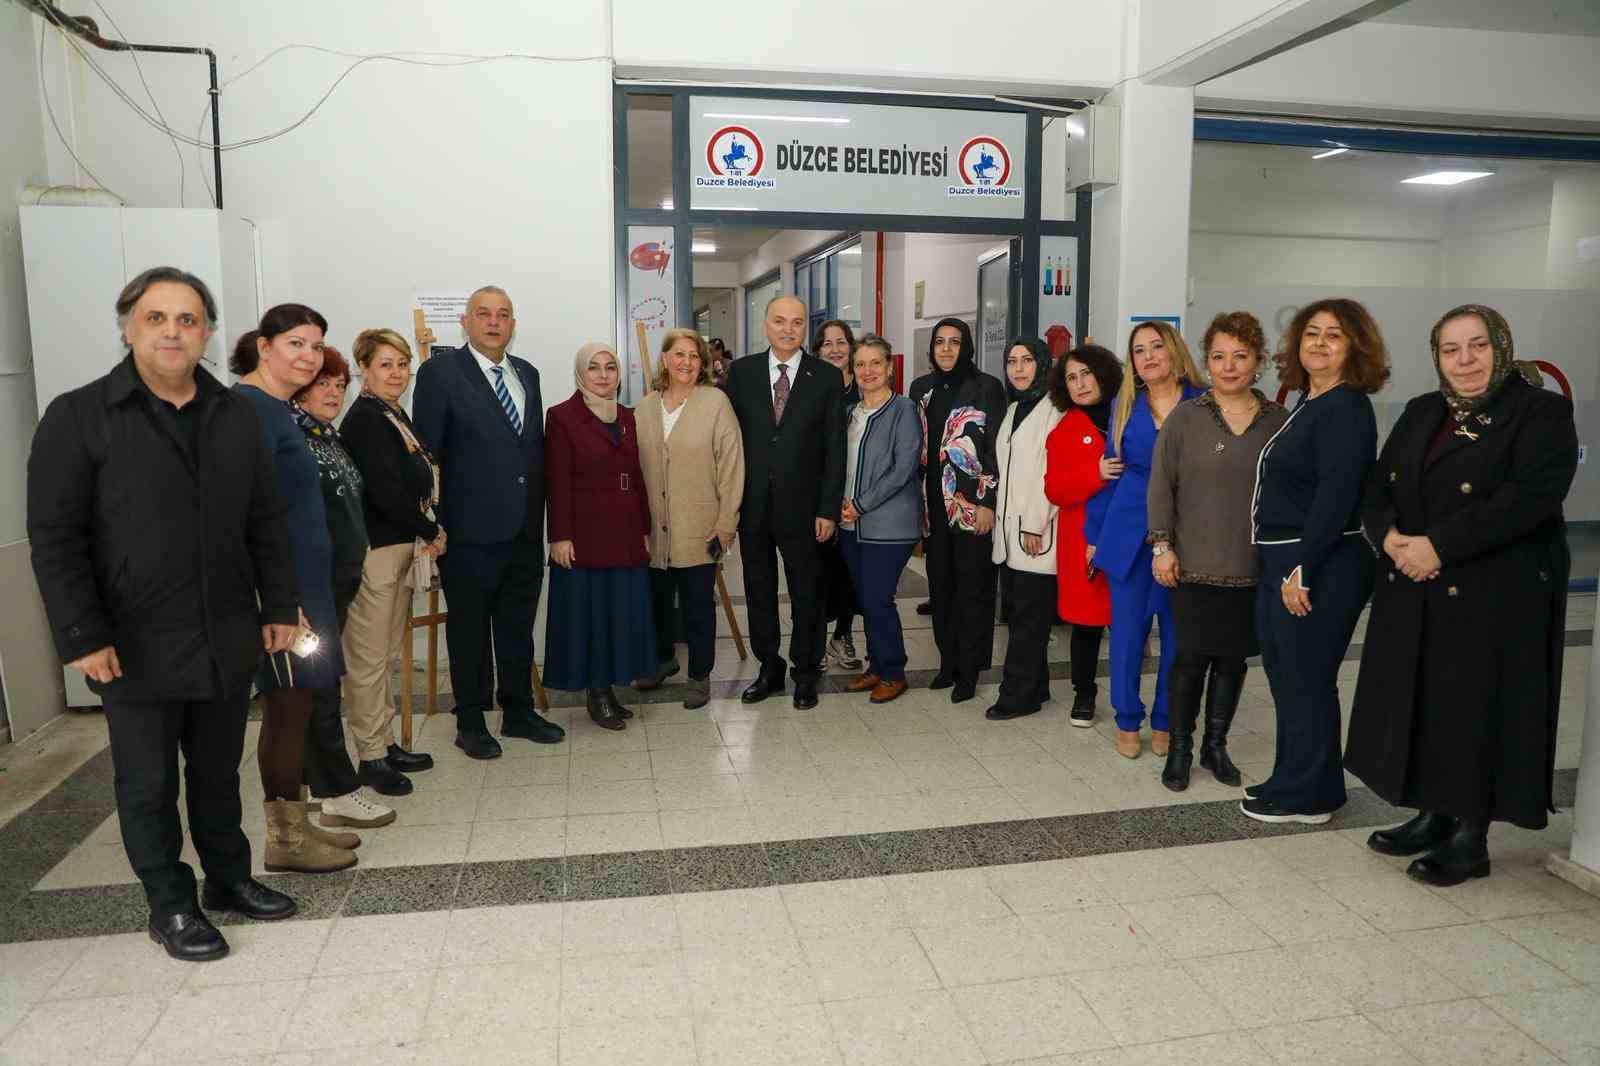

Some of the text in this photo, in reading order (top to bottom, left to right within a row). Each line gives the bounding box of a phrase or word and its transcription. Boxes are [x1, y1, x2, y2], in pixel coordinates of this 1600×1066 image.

[776, 139, 948, 177] DÜZCE BELEDİYESİ
[727, 178, 774, 188] Belediyesi
